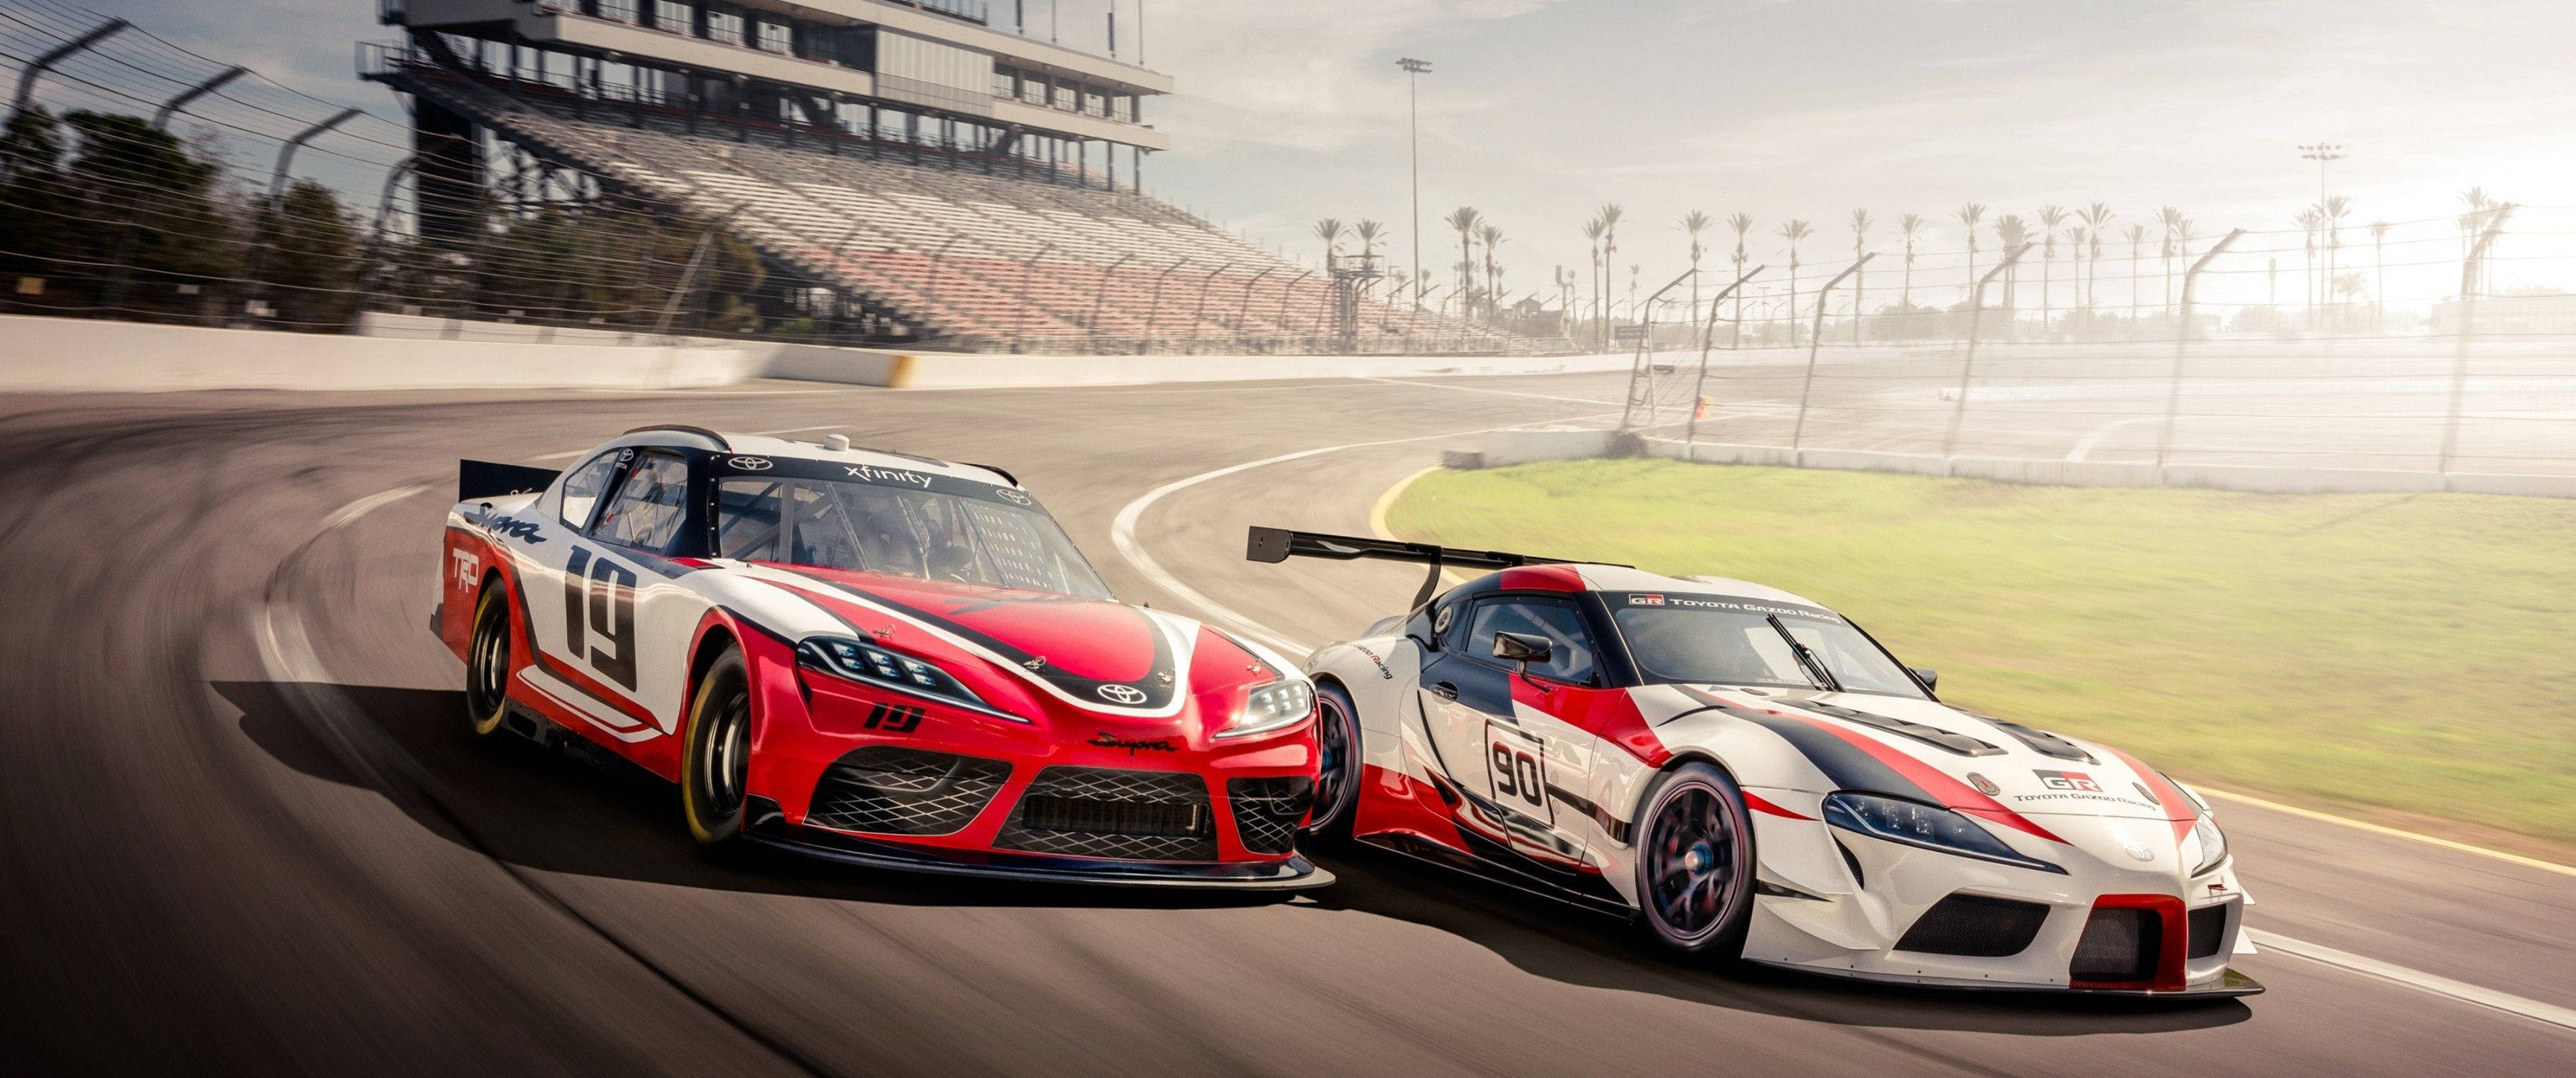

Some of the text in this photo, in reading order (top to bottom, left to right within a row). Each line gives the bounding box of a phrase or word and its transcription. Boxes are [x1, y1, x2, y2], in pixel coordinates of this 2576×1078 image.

[843, 464, 932, 488] xfinity
[464, 502, 547, 544] Supra
[452, 547, 479, 593] TRD
[1630, 597, 1663, 606] GR
[1669, 598, 1740, 609] TOYOTA
[1798, 609, 1841, 624] Racing
[565, 544, 637, 693] 19
[1370, 654, 1393, 680] Racing
[863, 702, 926, 734] 19
[1087, 731, 1181, 758] Supra
[1492, 741, 1543, 807] 90
[2041, 776, 2103, 793] GR
[2013, 794, 2068, 803] TOYOTA
[2115, 797, 2157, 811] Racing
